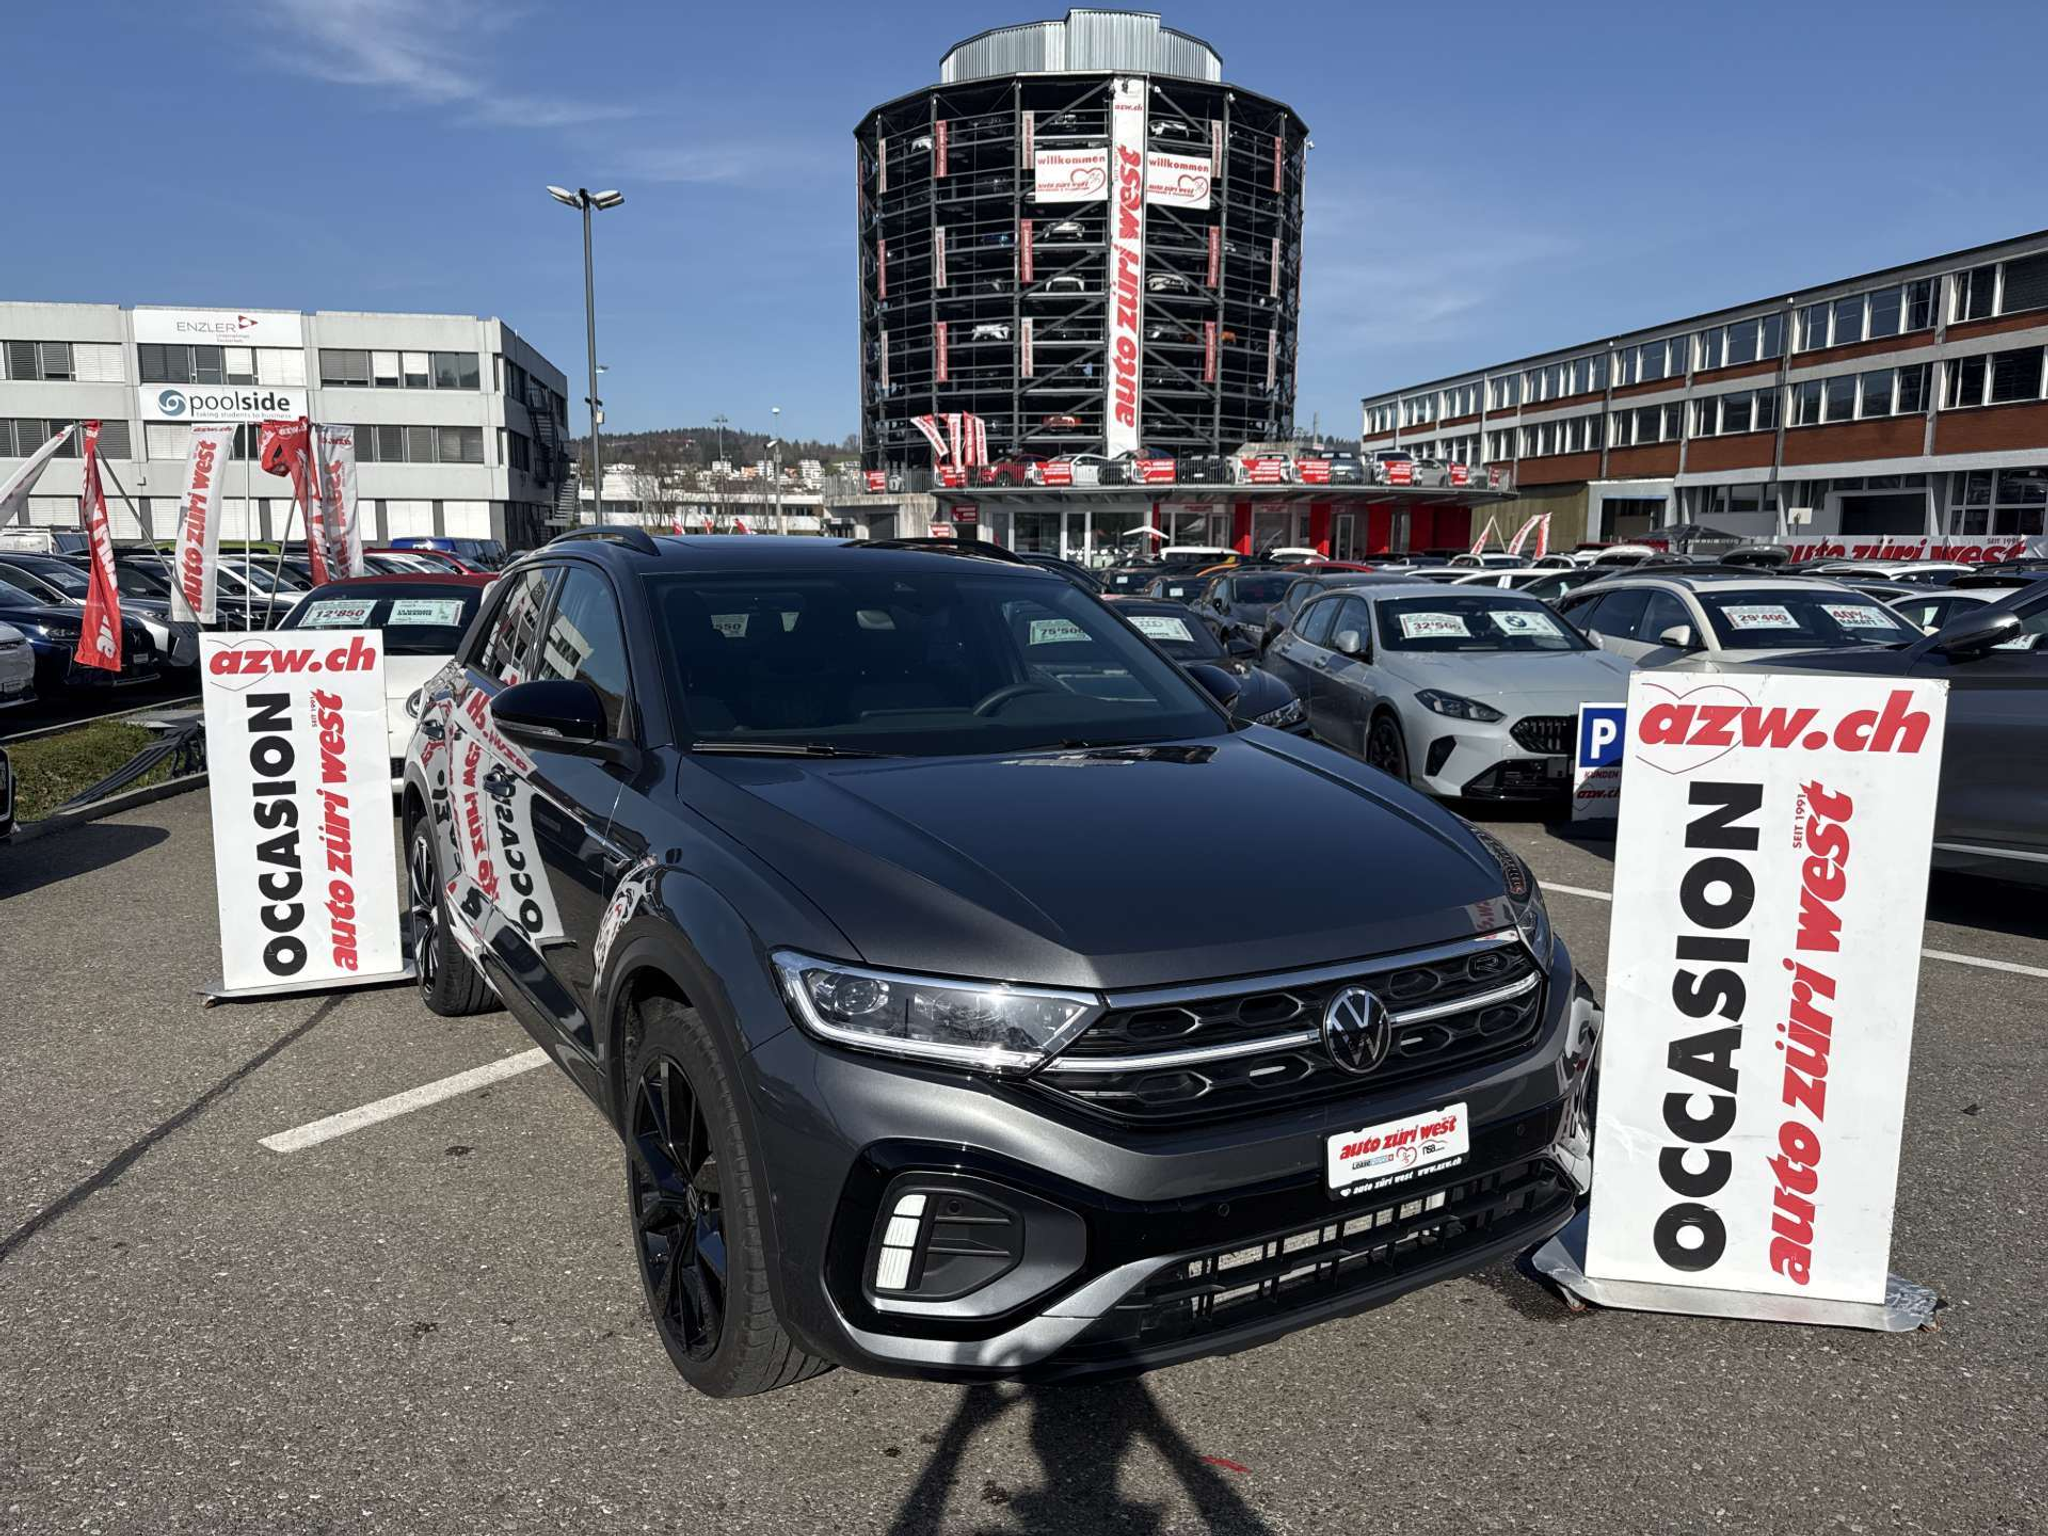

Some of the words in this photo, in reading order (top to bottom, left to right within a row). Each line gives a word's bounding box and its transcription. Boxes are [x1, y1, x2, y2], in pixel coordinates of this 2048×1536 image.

[1037, 155, 1106, 165] willkommen
[1149, 157, 1209, 172] willkommen
[1116, 143, 1141, 240] west
[1111, 242, 1139, 335] züri
[176, 321, 236, 333] ENZLER
[189, 391, 291, 417] poolside
[1112, 335, 1137, 428] auto
[192, 440, 217, 490] west
[185, 491, 208, 548] züri
[181, 549, 203, 613] auto
[315, 609, 365, 618] 12'850
[1738, 613, 1788, 623] 29'400
[209, 636, 377, 675] azw.ch
[311, 688, 348, 784] west
[1590, 718, 1617, 760] P
[1637, 690, 1931, 754] azw.ch
[1584, 770, 1620, 778] KUNDEN
[316, 788, 353, 878] züri
[1795, 794, 1806, 820] 1991
[246, 692, 307, 977] OCCASION
[1792, 825, 1804, 849] SEIT
[1797, 779, 1855, 953] west
[324, 879, 359, 972] auto
[1653, 781, 1764, 1273] OCCASION
[1774, 957, 1838, 1123] züri
[1339, 1136, 1381, 1160] auto
[1382, 1124, 1419, 1151] züri
[1420, 1115, 1458, 1139] west
[1353, 1183, 1373, 1194] auto
[1374, 1176, 1393, 1189] züri
[1394, 1171, 1414, 1184] west
[1765, 1120, 1824, 1286] auto
